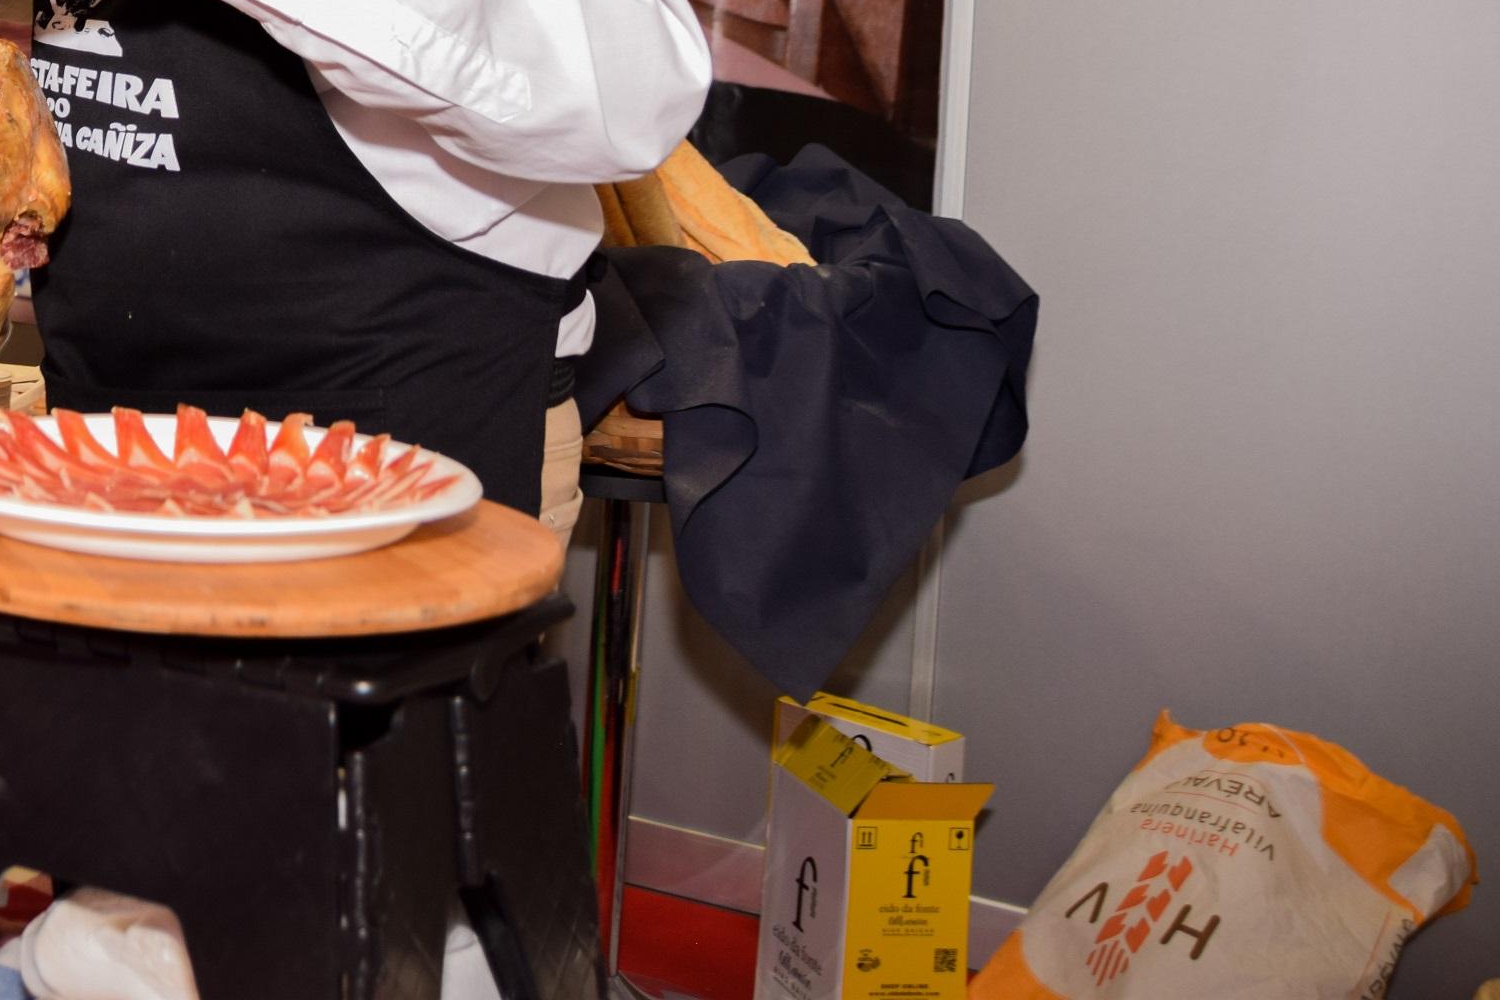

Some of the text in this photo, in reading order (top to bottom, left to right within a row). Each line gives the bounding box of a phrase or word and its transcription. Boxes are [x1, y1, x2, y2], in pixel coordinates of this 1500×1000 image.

[30, 58, 179, 118] STA-FEIRA
[75, 122, 181, 172] CAÑIZA
[1130, 802, 1276, 861] Vilafranquina
[1140, 818, 1240, 857] Harinera
